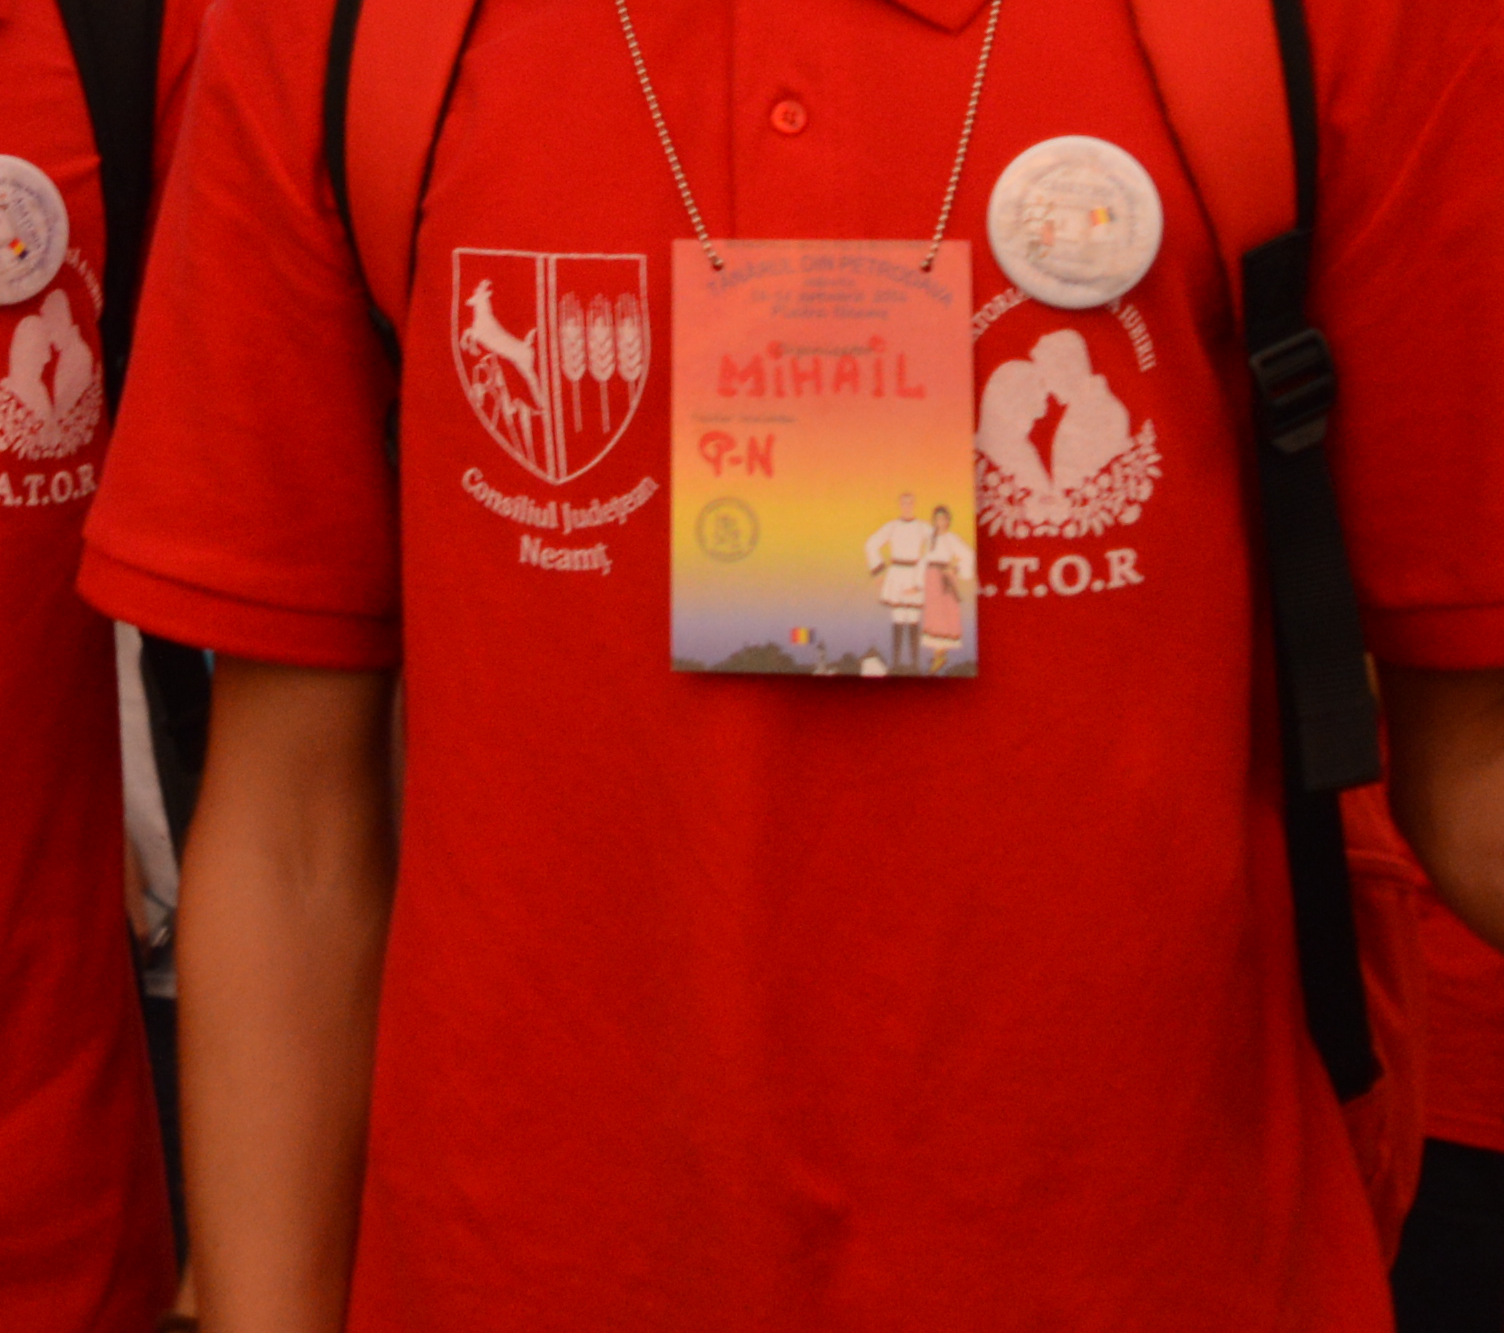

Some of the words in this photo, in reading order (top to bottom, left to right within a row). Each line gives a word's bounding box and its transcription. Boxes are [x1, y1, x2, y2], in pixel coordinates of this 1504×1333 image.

[461, 466, 559, 530] Consiliul
[518, 533, 613, 577] Neamț
[977, 547, 1146, 598] .T.O.R
